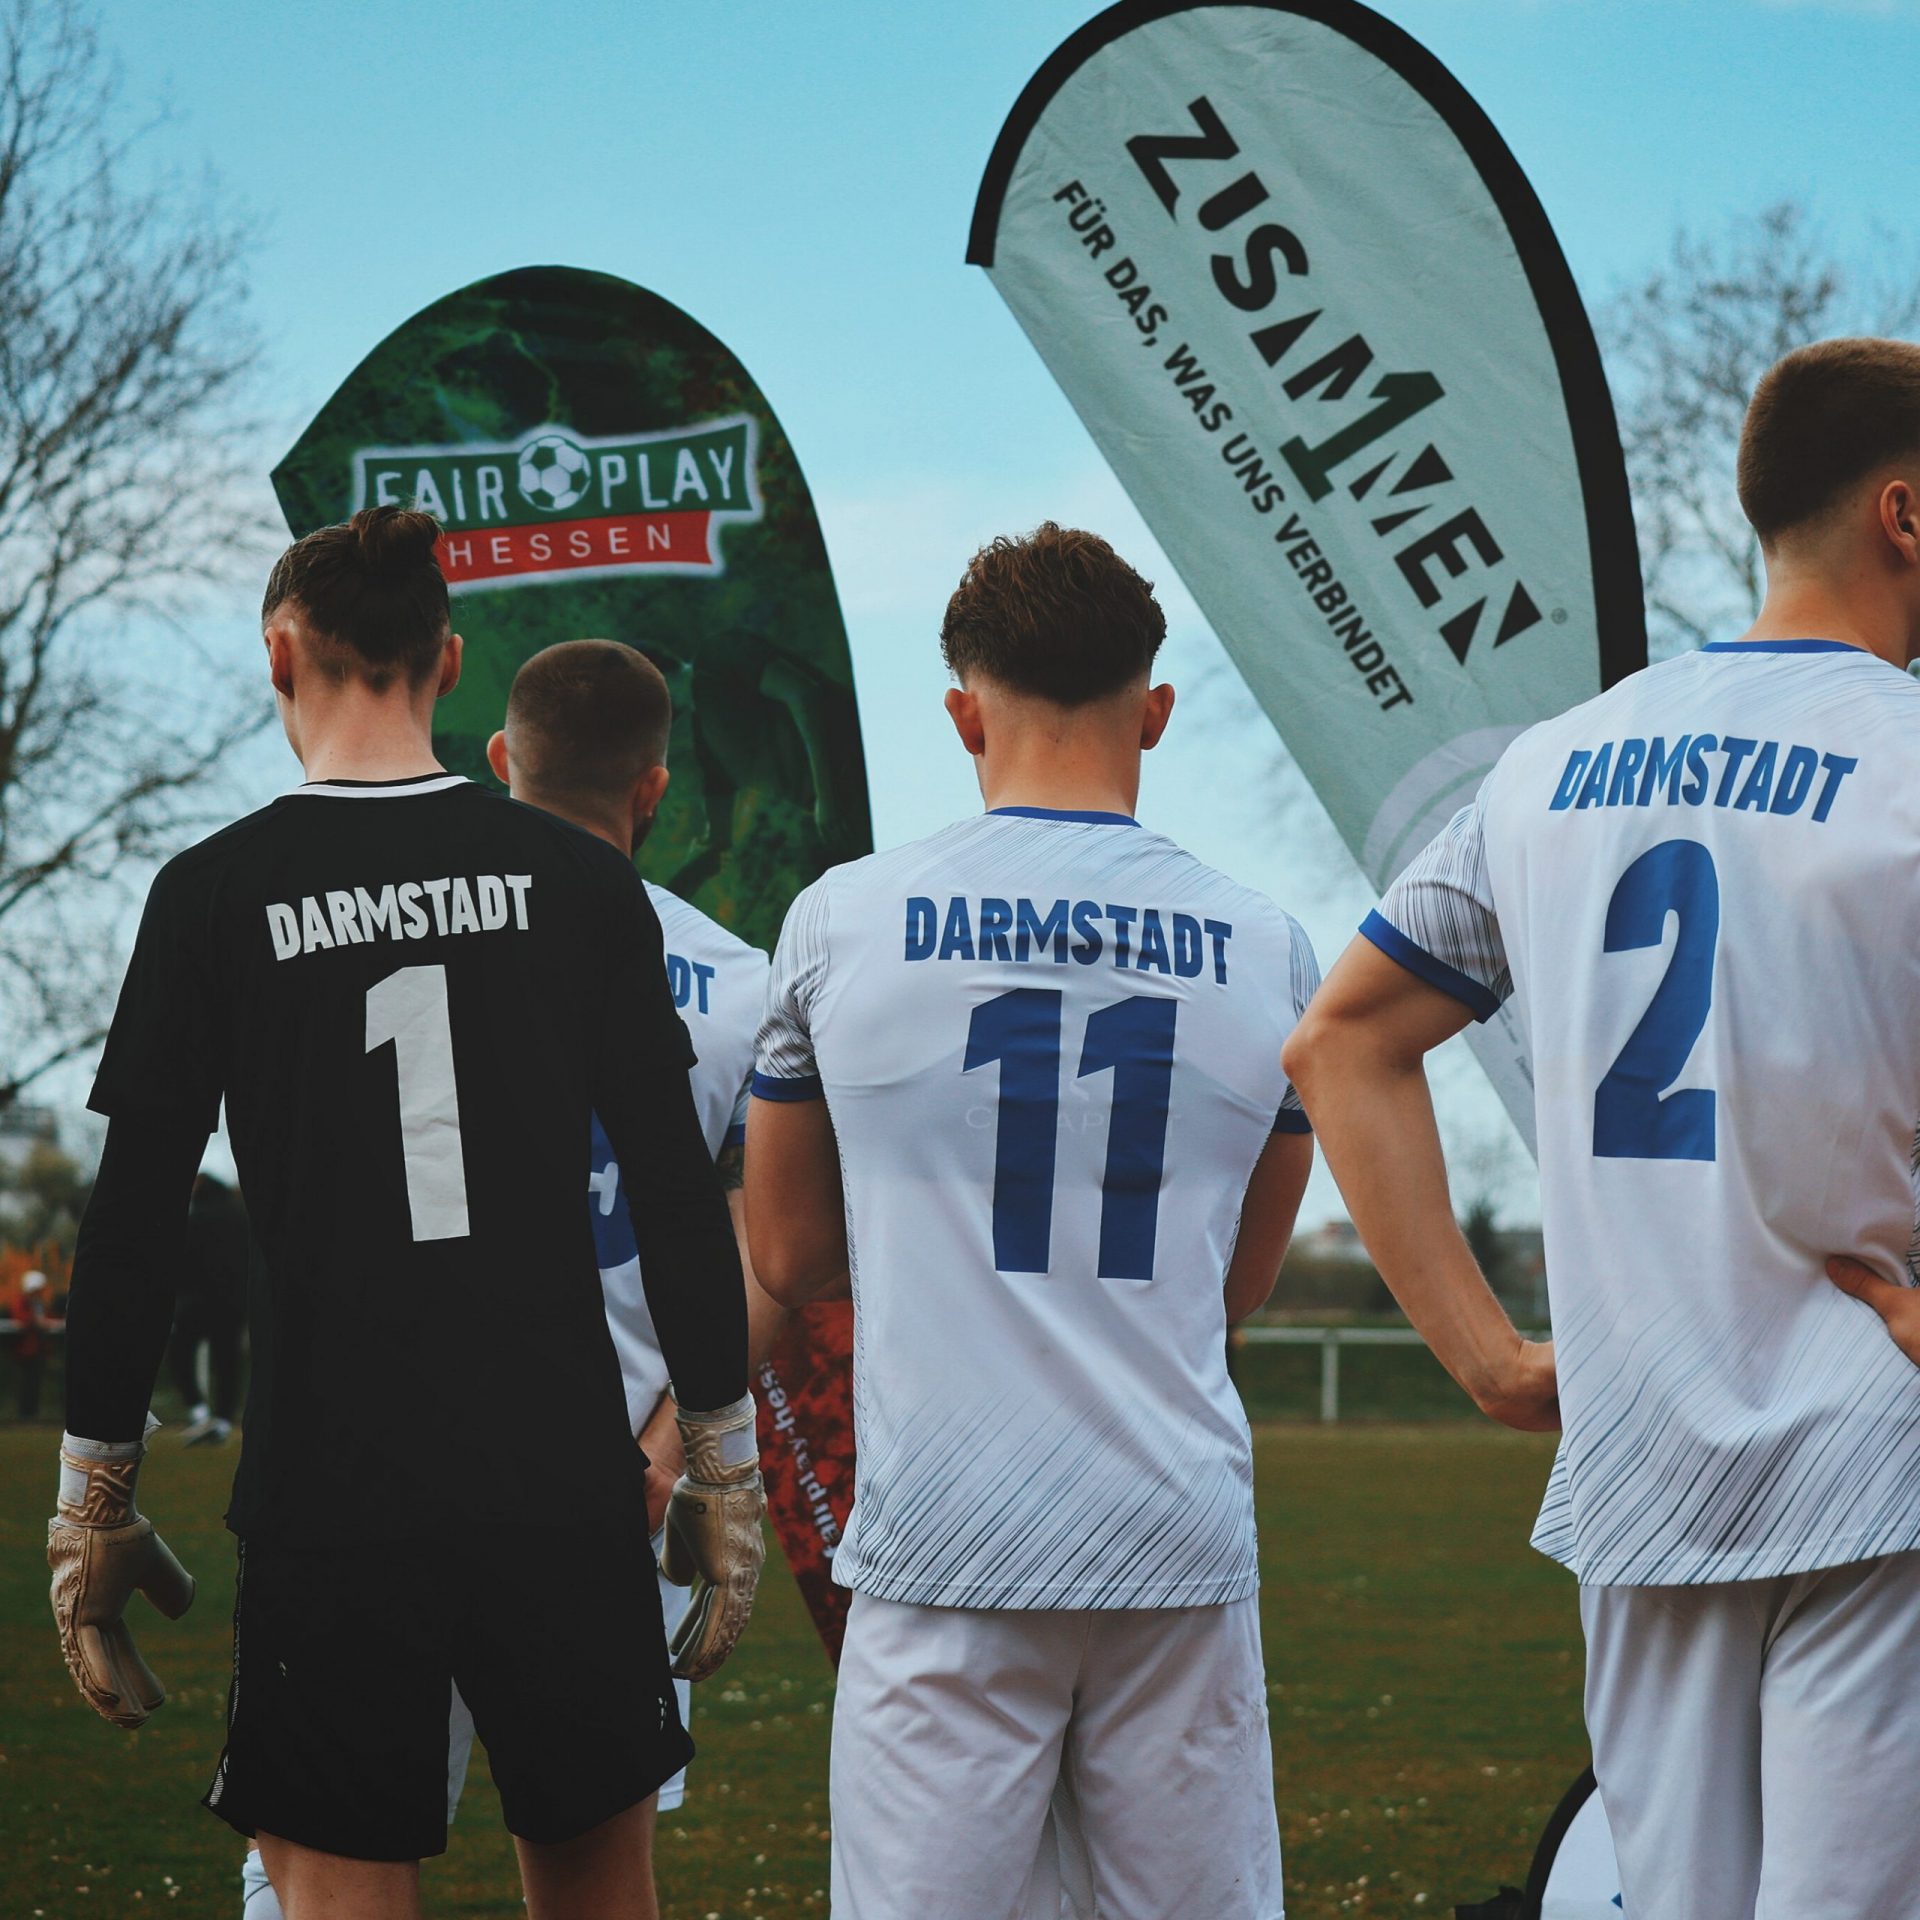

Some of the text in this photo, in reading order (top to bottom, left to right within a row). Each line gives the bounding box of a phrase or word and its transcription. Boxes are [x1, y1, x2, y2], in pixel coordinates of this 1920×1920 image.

[376, 447, 733, 522] FAIR PLAY
[1053, 180, 1414, 712] FÜR DAS, WAS UNS VERBINDET
[448, 523, 671, 567] HESSEN
[1549, 734, 1857, 823] DARMSTADT
[265, 874, 532, 961] DARMSTADT
[904, 896, 1233, 985] DARMSTADT
[1593, 840, 1719, 1161] 2
[365, 964, 471, 1242] 1
[962, 987, 1178, 1281] 11
